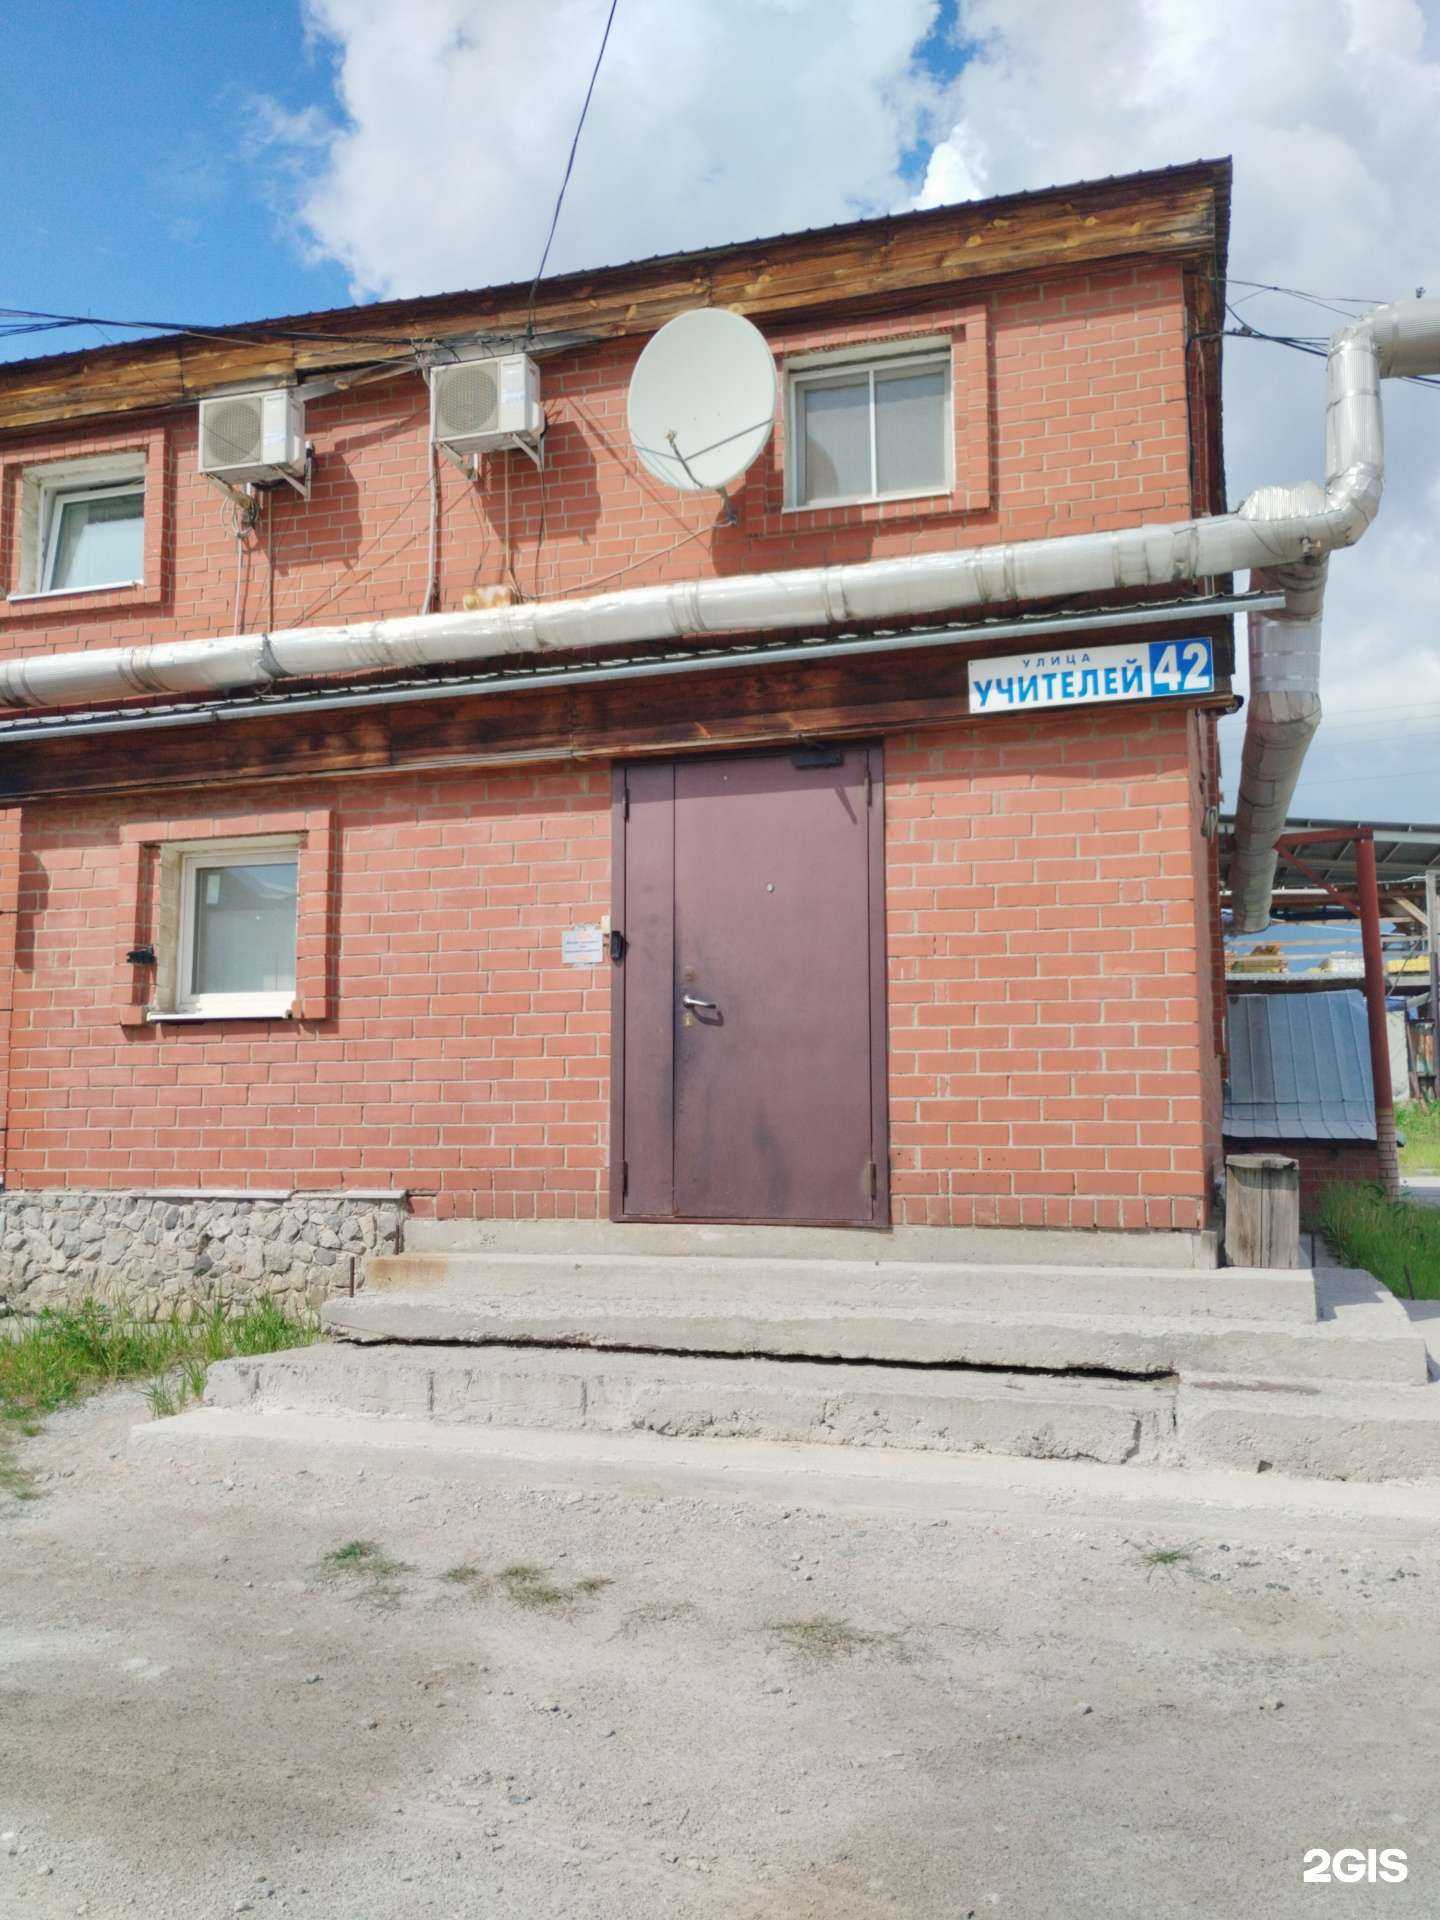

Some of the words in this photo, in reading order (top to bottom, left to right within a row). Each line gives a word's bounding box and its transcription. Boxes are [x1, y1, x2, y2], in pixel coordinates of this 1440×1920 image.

[973, 658, 1144, 707] УЧИТЕЛЕЙ
[1153, 642, 1210, 691] 42
[1022, 653, 1091, 669] УЛИЦА
